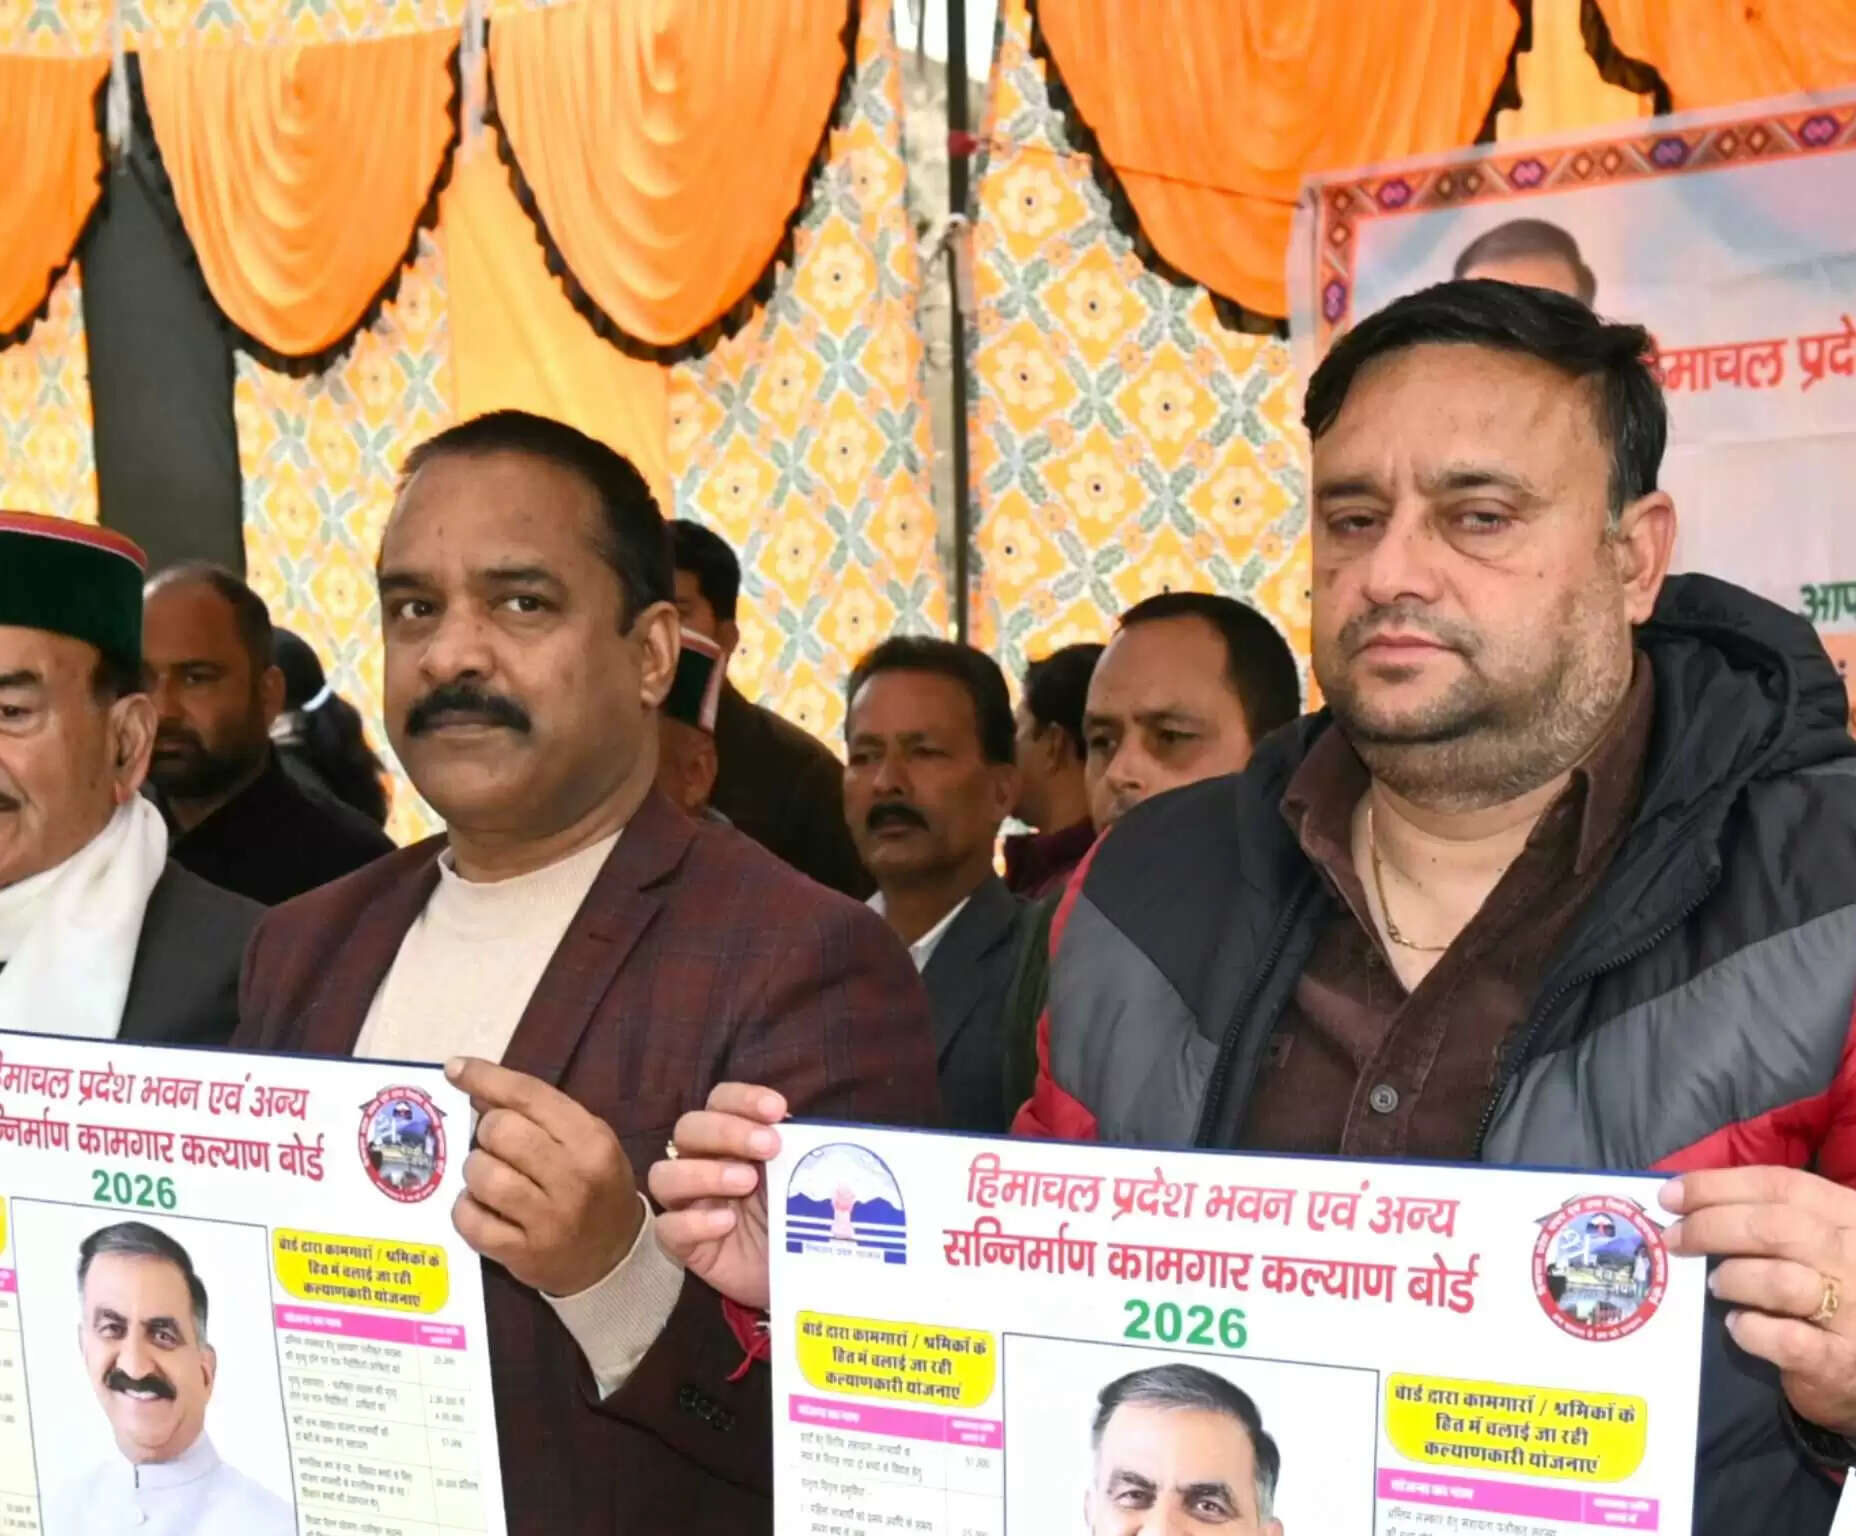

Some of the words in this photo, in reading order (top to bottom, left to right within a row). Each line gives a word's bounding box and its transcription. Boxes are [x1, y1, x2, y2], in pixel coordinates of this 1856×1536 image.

[1651, 336, 1786, 392] माचल
[78, 1061, 136, 1105] प्रदेश
[140, 1076, 203, 1110] भवन
[208, 1073, 251, 1115] एवं
[251, 1086, 310, 1121] अन्य
[76, 1124, 175, 1163] कामगार
[180, 1134, 271, 1172] कल्याण
[277, 1133, 324, 1181] बोर्ड
[92, 1170, 176, 1209] 2026
[967, 1153, 1106, 1213] हिमाचल
[1112, 1166, 1199, 1221] प्रदेश
[1205, 1185, 1297, 1226] भवन
[1307, 1180, 1375, 1232] एवं
[1375, 1196, 1460, 1238] अन्य
[942, 1216, 1098, 1277] सन्निर्माण
[1107, 1243, 1254, 1291] कामगार
[1261, 1255, 1397, 1303] कल्याण
[1408, 1253, 1480, 1314] बोर्ड
[1123, 1299, 1247, 1348] 2026
